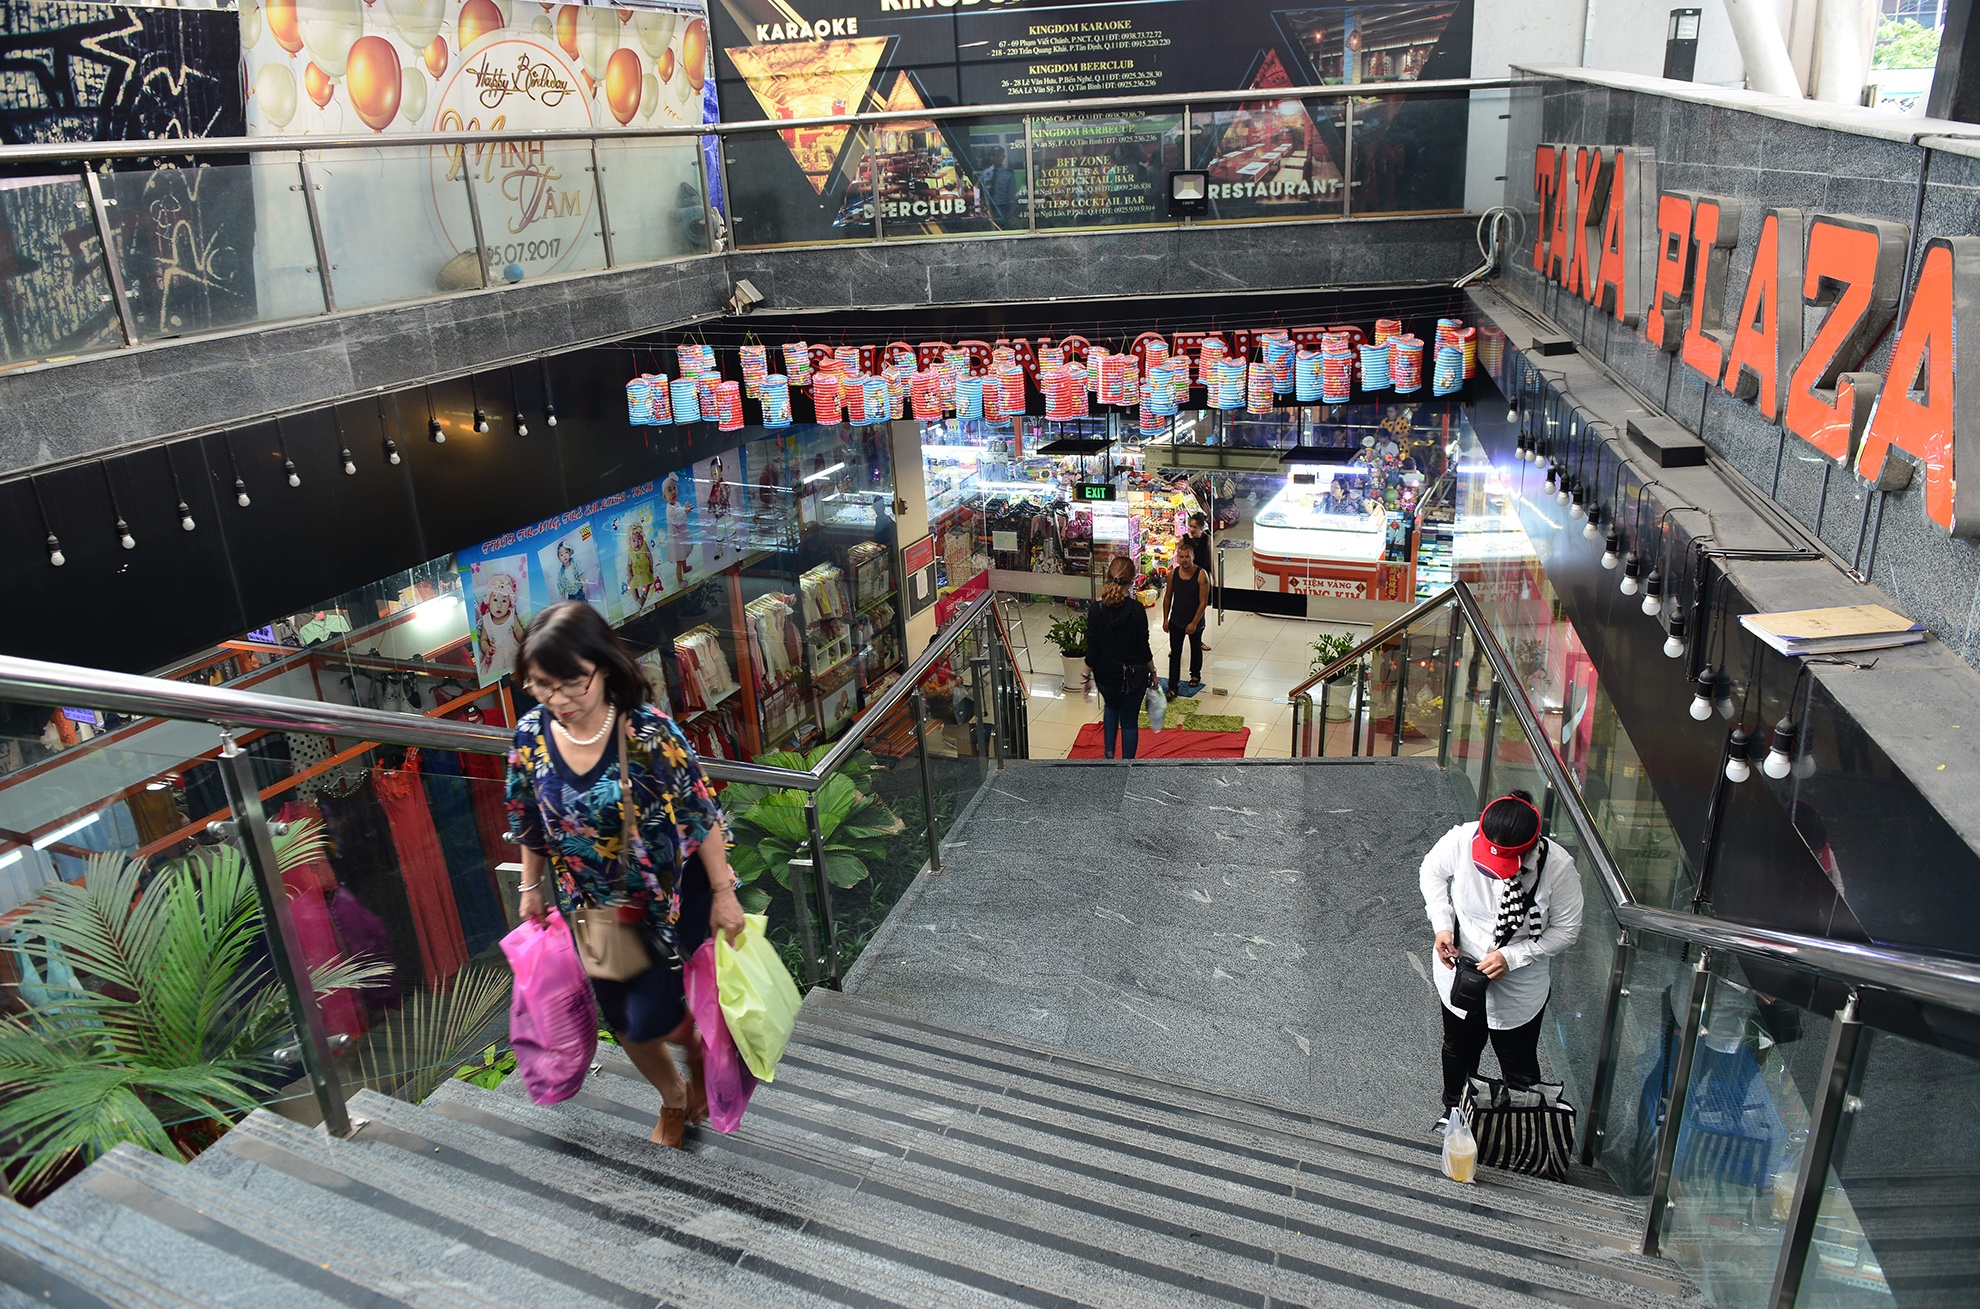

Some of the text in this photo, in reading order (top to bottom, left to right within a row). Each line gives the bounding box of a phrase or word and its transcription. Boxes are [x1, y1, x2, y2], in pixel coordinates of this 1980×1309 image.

[756, 17, 858, 41] KARAOKE
[1029, 19, 1132, 35] KINGDOM KARAOKE
[998, 40, 1007, 48] 67
[1010, 39, 1019, 47] 69
[1121, 30, 1162, 40] 0938.73.72.72
[991, 49, 1003, 57] 218
[1006, 47, 1019, 56] 220
[1032, 46, 1053, 55] Quang
[1131, 38, 1171, 48] 0915.220.220
[1029, 60, 1134, 75] KINGDOM BEERCLUB
[466, 52, 576, 109] Happy Birthday
[1001, 79, 1010, 87] 26
[1013, 78, 1022, 86] 28
[1121, 71, 1163, 80] 0925.26.28.30
[1007, 87, 1024, 95] 236A
[1117, 79, 1157, 88] 0925.236.236
[1031, 124, 1135, 139] KINGDOM BARBECUE
[1118, 134, 1157, 143] 0925.236.236
[439, 108, 546, 183] MINH
[1057, 155, 1111, 167] BFF ZONE
[1035, 173, 1135, 187] CU29 COCKTAIL BAR
[1041, 168, 1070, 178] YOLO
[1071, 167, 1091, 177] PUB
[1092, 166, 1100, 175] &
[1208, 178, 1339, 199] RESTAURANT
[501, 165, 582, 234] TÂM
[1033, 195, 1145, 209] OUTE99 COCKTAIL BAR
[1532, 144, 1960, 538] TAKA PLAZA
[1085, 486, 1106, 499] EXIT
[516, 516, 562, 542] TRANG
[584, 501, 600, 517] EM
[1302, 578, 1352, 589] TIỆM VÀNG
